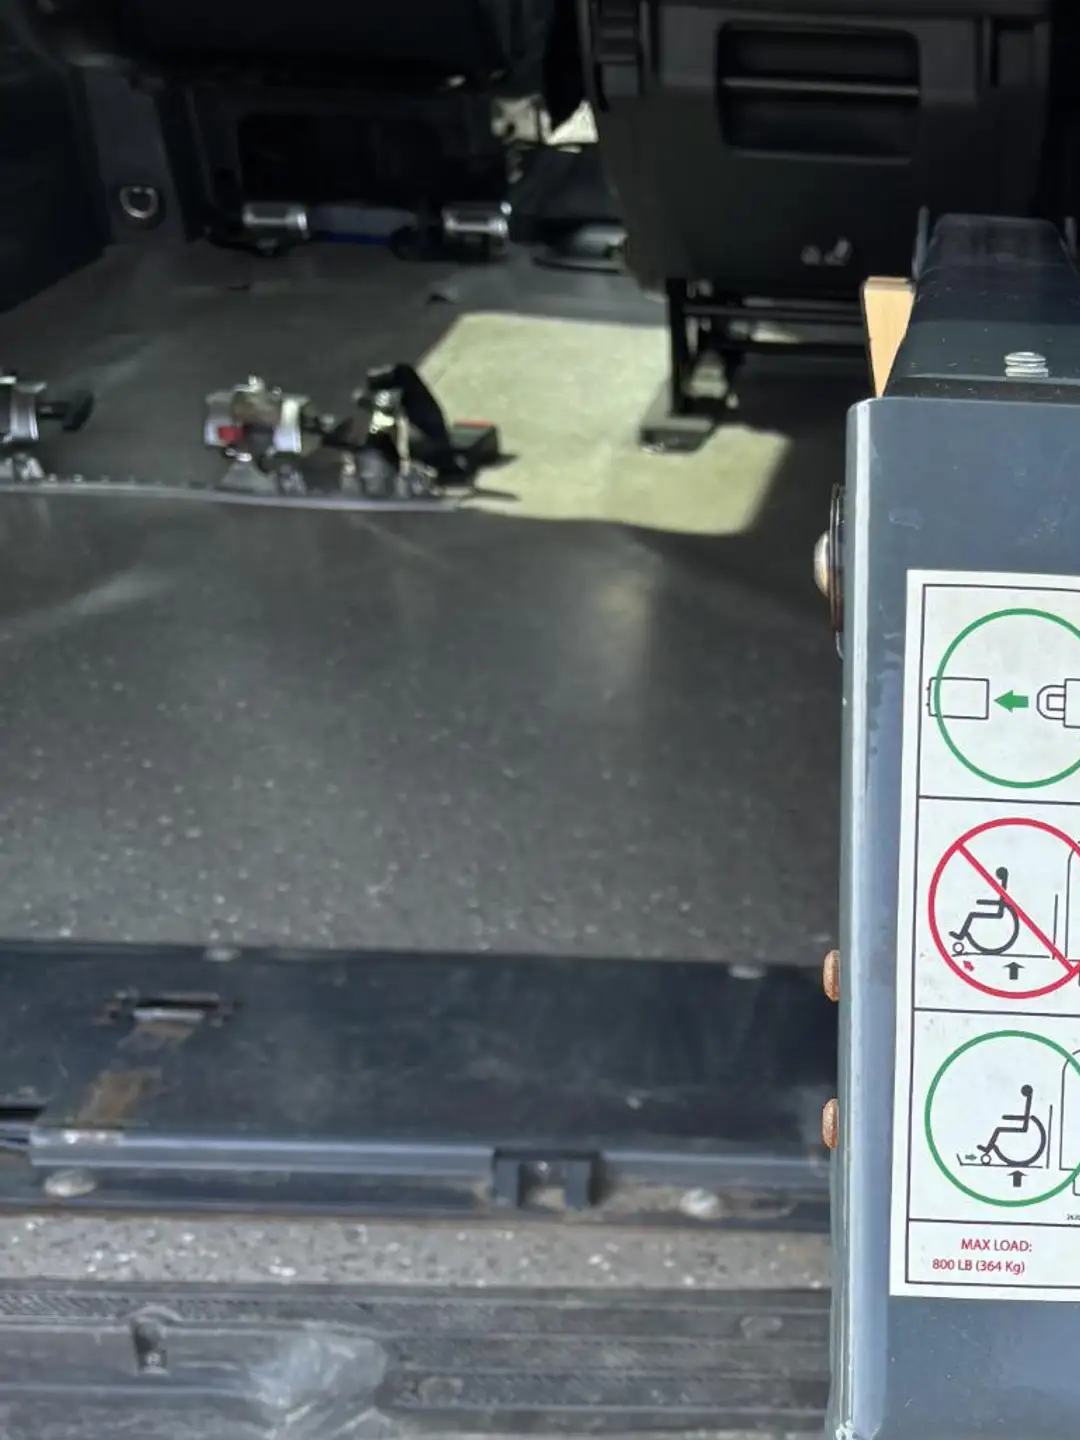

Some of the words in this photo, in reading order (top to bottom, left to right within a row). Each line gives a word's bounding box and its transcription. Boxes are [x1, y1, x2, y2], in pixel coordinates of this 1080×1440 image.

[961, 1238, 990, 1251] MAX
[994, 1240, 1032, 1253] LOAD:
[932, 1258, 955, 1270] 800
[958, 1260, 973, 1271] LB
[975, 1260, 1002, 1272] (364
[1005, 1260, 1025, 1275] Kg)
